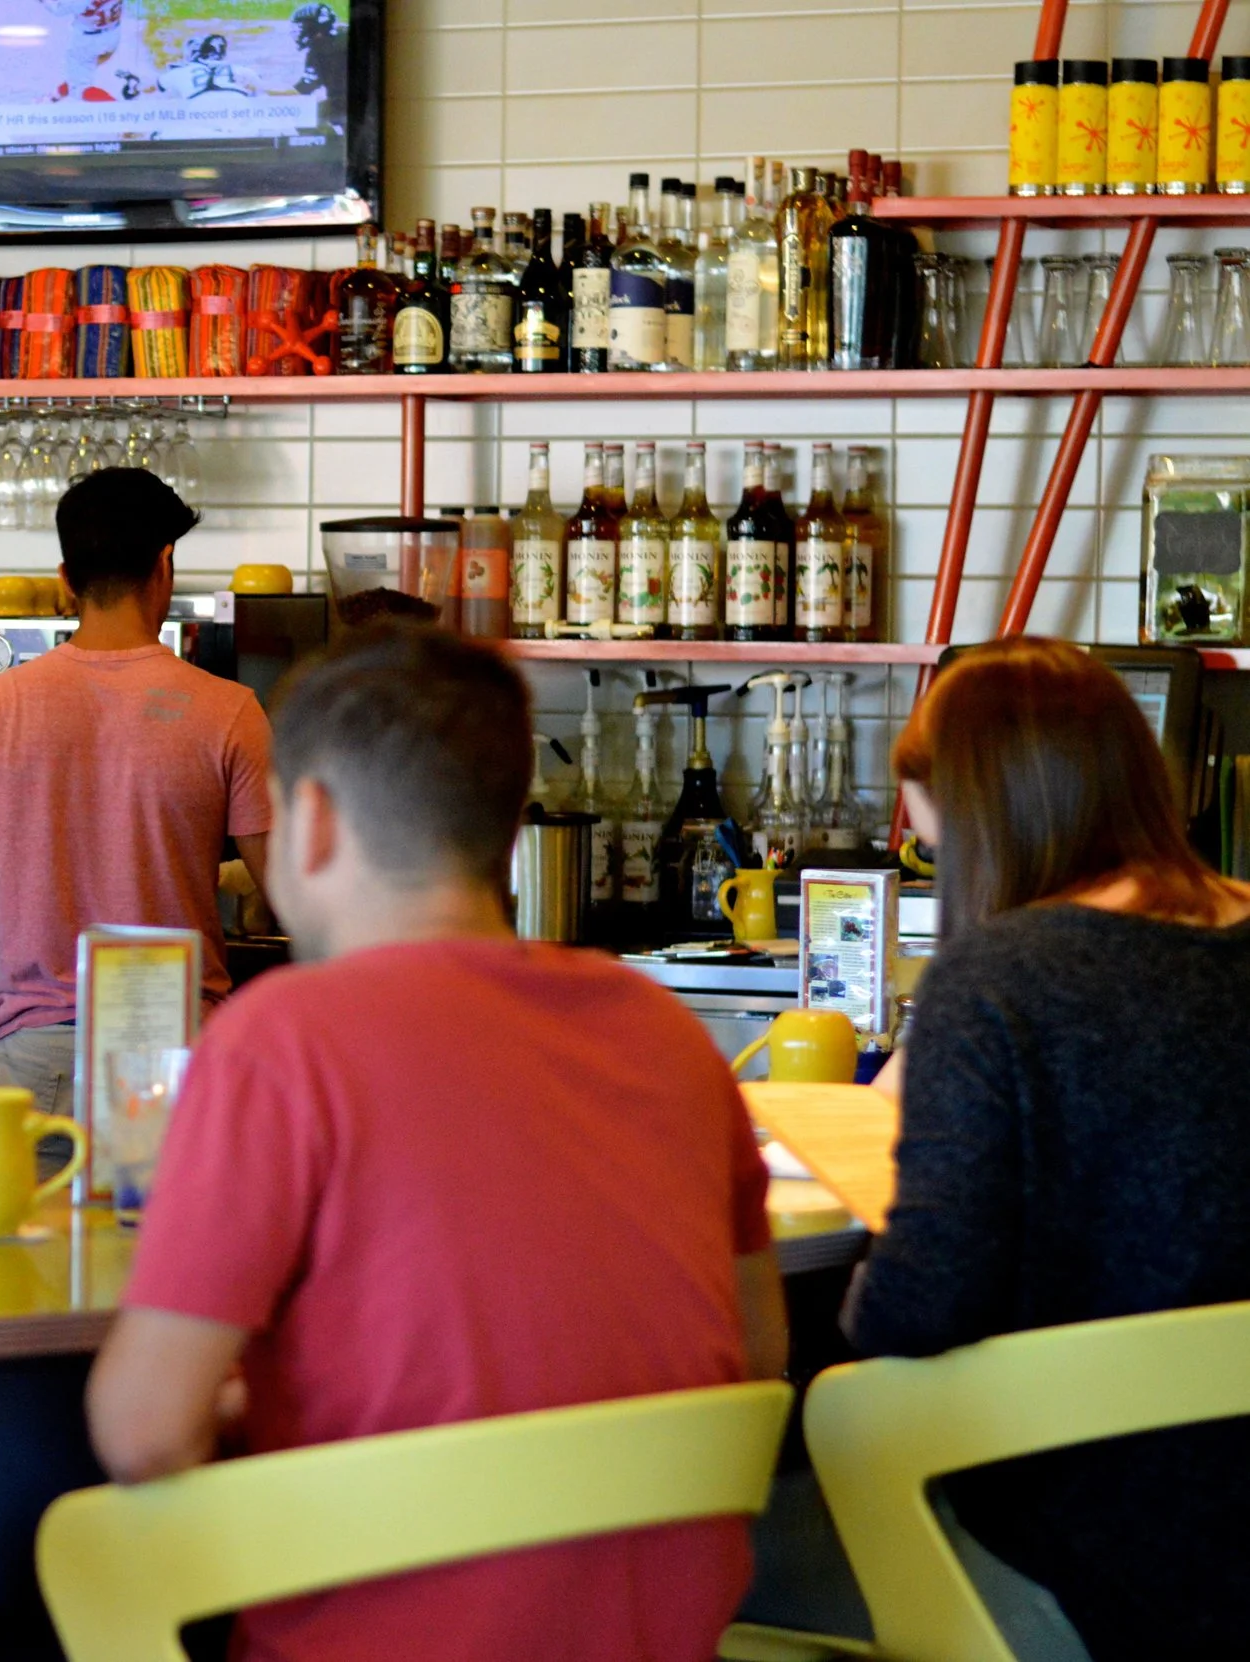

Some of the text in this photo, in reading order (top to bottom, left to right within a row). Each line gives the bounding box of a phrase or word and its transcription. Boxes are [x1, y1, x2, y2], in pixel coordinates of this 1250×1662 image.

[6, 113, 24, 125] HR
[27, 112, 48, 125] this
[52, 112, 94, 124] season
[119, 110, 139, 123] shy
[143, 109, 155, 121] of
[159, 109, 185, 121] MLB
[189, 107, 228, 120] record
[231, 107, 249, 118] set
[253, 107, 264, 118] in
[515, 551, 553, 561] MONIN
[569, 551, 610, 561] MONIN
[620, 551, 658, 561] MONIN
[670, 551, 710, 561] MONIN
[729, 551, 768, 561] MONIN
